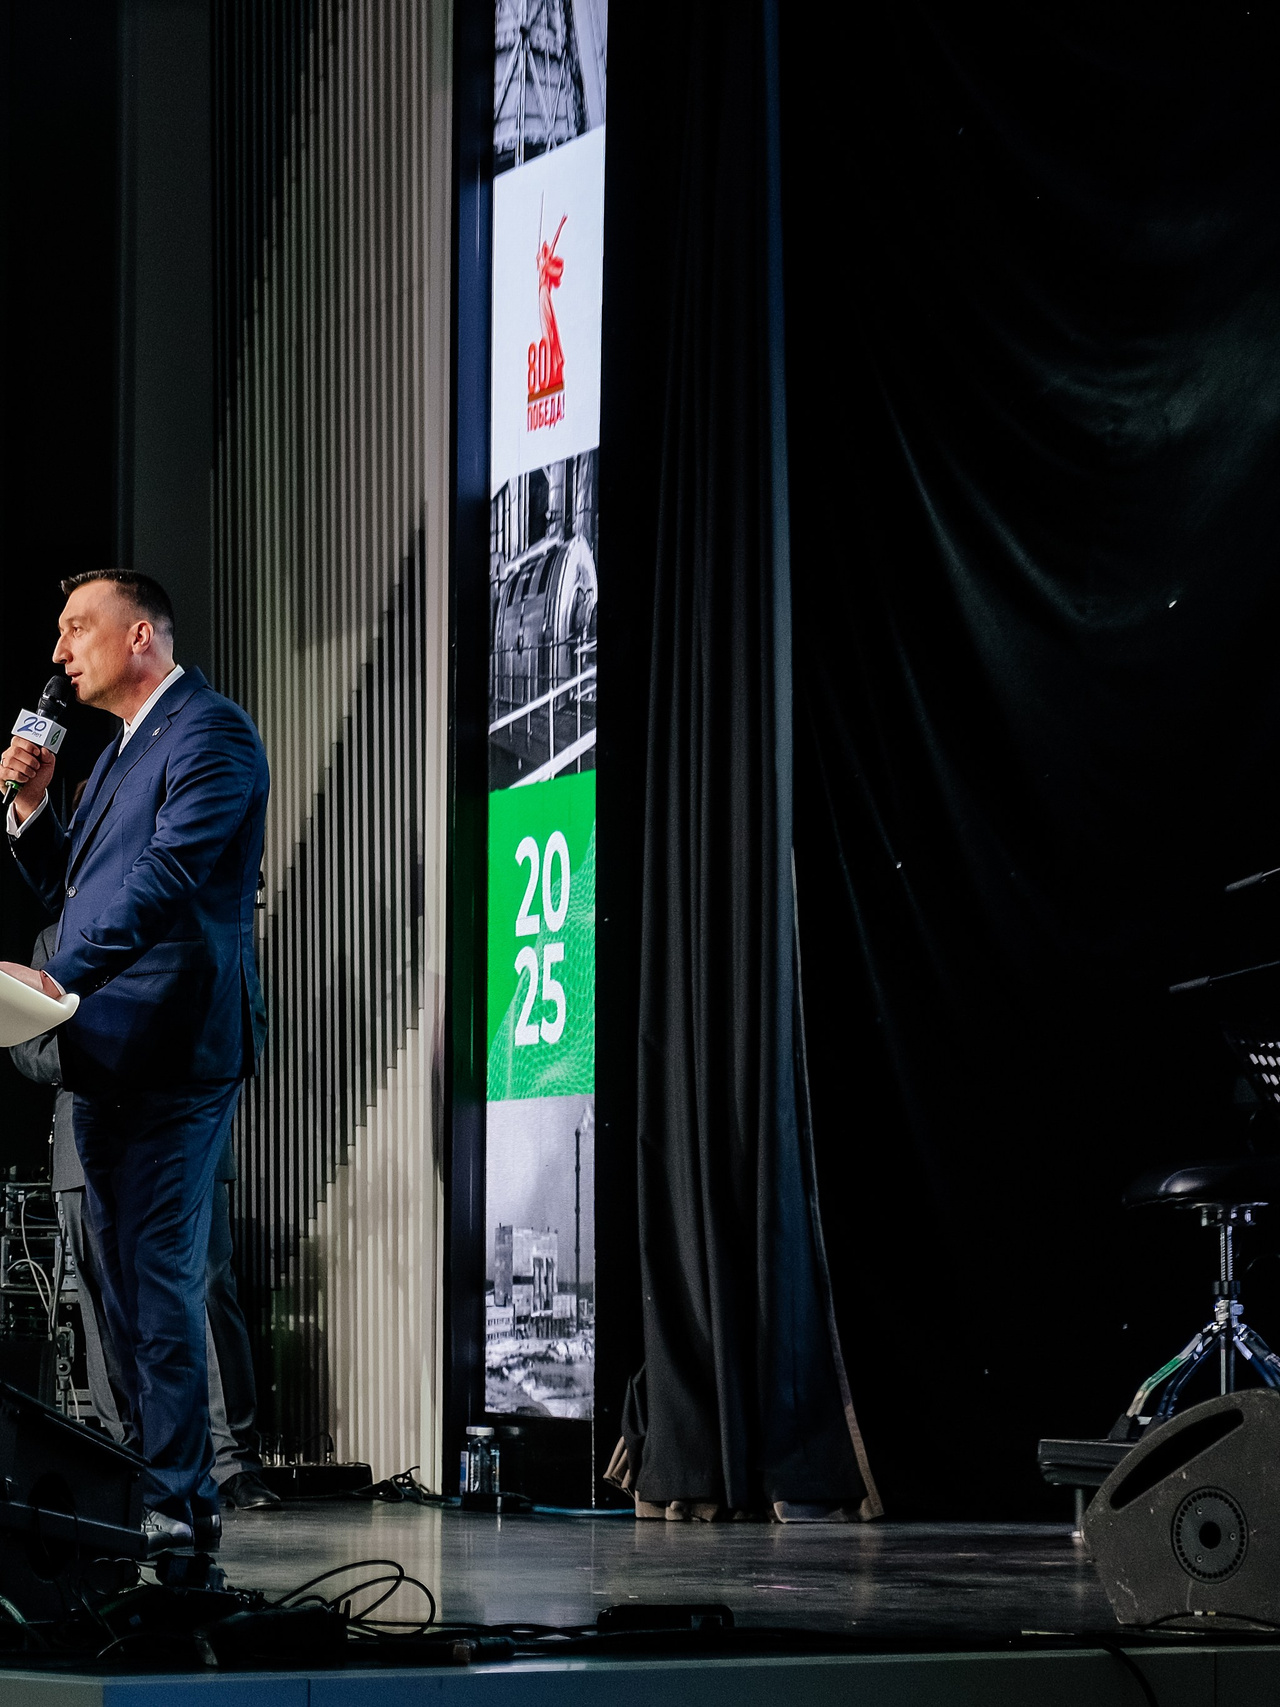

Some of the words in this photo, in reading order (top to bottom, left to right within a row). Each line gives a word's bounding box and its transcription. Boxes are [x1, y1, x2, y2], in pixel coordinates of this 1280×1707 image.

[528, 338, 550, 394] 80
[527, 394, 565, 432] ПОБЕДА!
[16, 716, 47, 732] 20
[515, 831, 570, 936] 20
[514, 942, 566, 1046] 25
